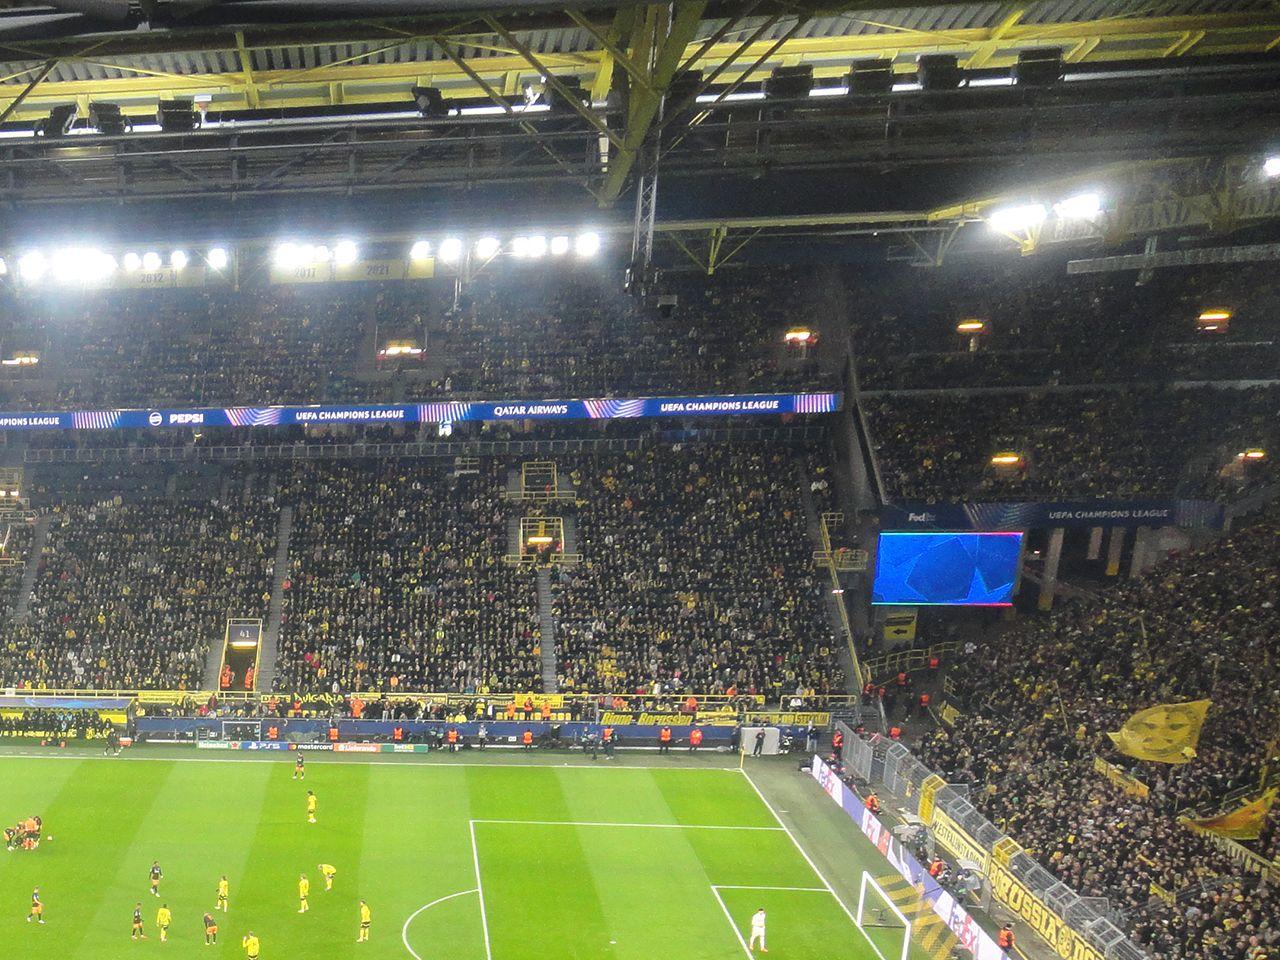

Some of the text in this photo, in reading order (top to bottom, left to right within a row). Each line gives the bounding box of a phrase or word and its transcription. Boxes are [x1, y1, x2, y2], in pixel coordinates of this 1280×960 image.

[494, 404, 568, 416] QATAR AIRWAYS
[660, 400, 779, 411] UEFA CHAMPIONS LEAGUE
[169, 413, 204, 423] PEPSI
[295, 409, 404, 420] UEFA CHAMPIONS LEAGUE
[29, 416, 60, 426] LEAGUE
[1049, 509, 1169, 519] UEFA CHAMPIONS LEAGUE
[989, 863, 1062, 948] BORUSSIA
[948, 900, 977, 954] FedEx
